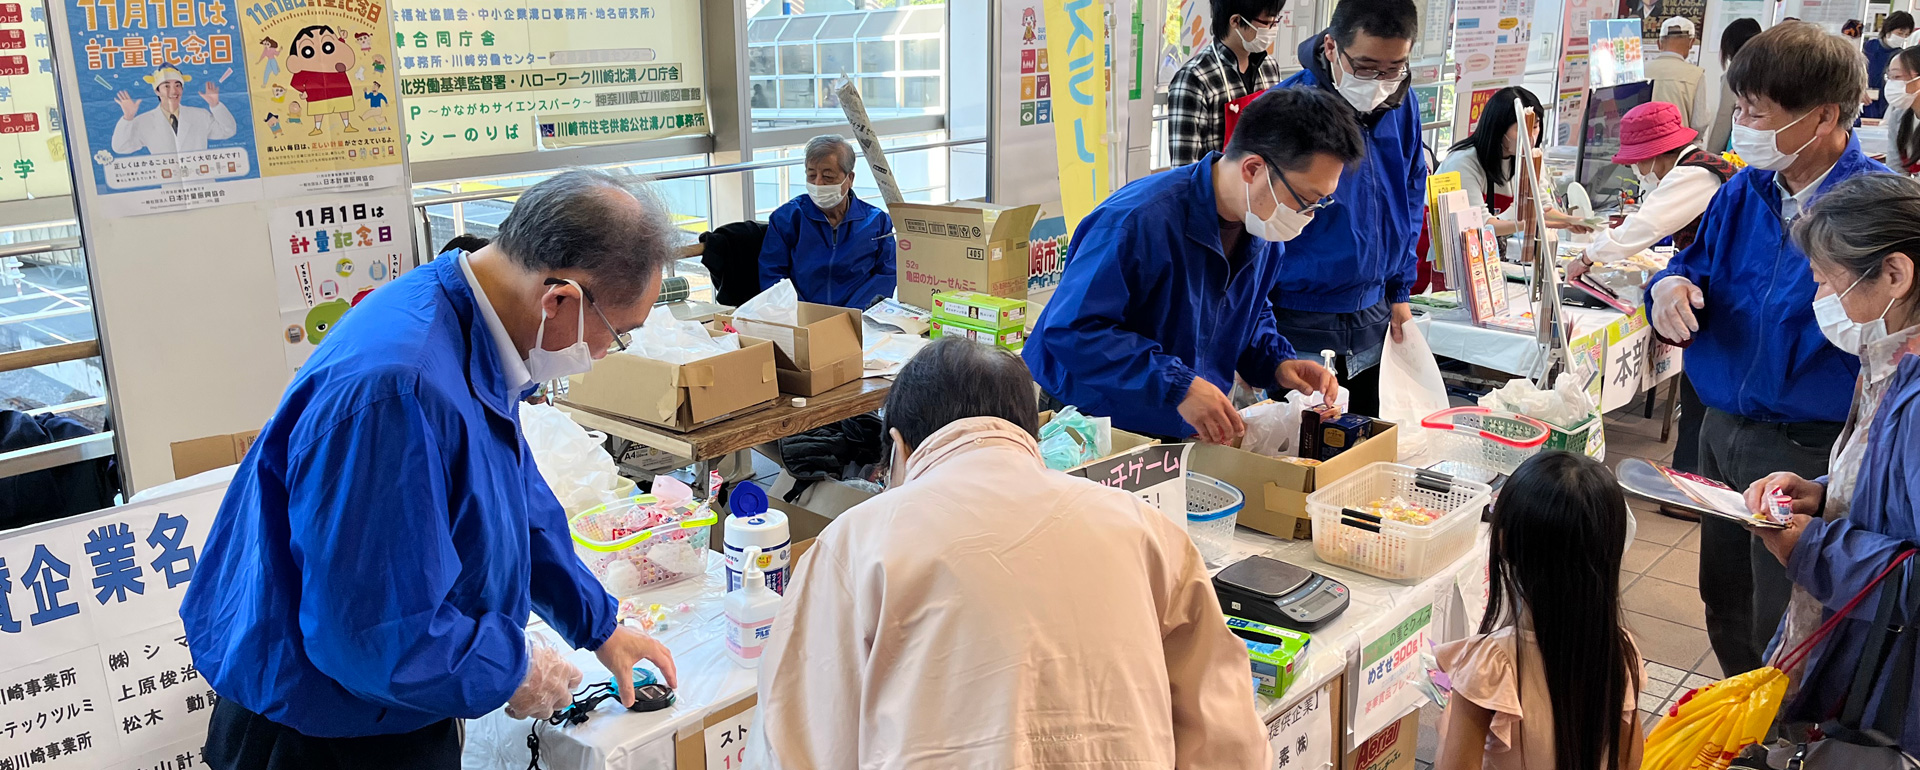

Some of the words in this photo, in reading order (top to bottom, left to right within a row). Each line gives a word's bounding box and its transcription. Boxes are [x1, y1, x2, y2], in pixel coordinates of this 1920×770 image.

[77, 0, 228, 31] 11月1日は
[85, 34, 234, 70] 計量記念日
[398, 52, 547, 70] 事務所・川崎労働センター
[595, 88, 701, 107] 神奈川県立川崎図書館
[3, 114, 11, 123] 5
[4, 125, 36, 133] のりば
[557, 112, 705, 138] 川崎市住宅供給公社溝ノ口事務所
[295, 203, 385, 228] 11月1日は
[289, 224, 392, 254] 計量記念日
[905, 260, 919, 270] 52g
[969, 249, 981, 258] 405
[1028, 235, 1068, 277] 崎市消
[300, 261, 314, 307] できるかな?
[905, 270, 977, 291] 亀田のカレーせんミニ
[624, 451, 636, 461] A4
[118, 663, 199, 702] 上原俊治
[122, 708, 164, 734] 松木
[0, 731, 92, 770] 株)川崎事業所
[1354, 718, 1401, 770] Aerial
